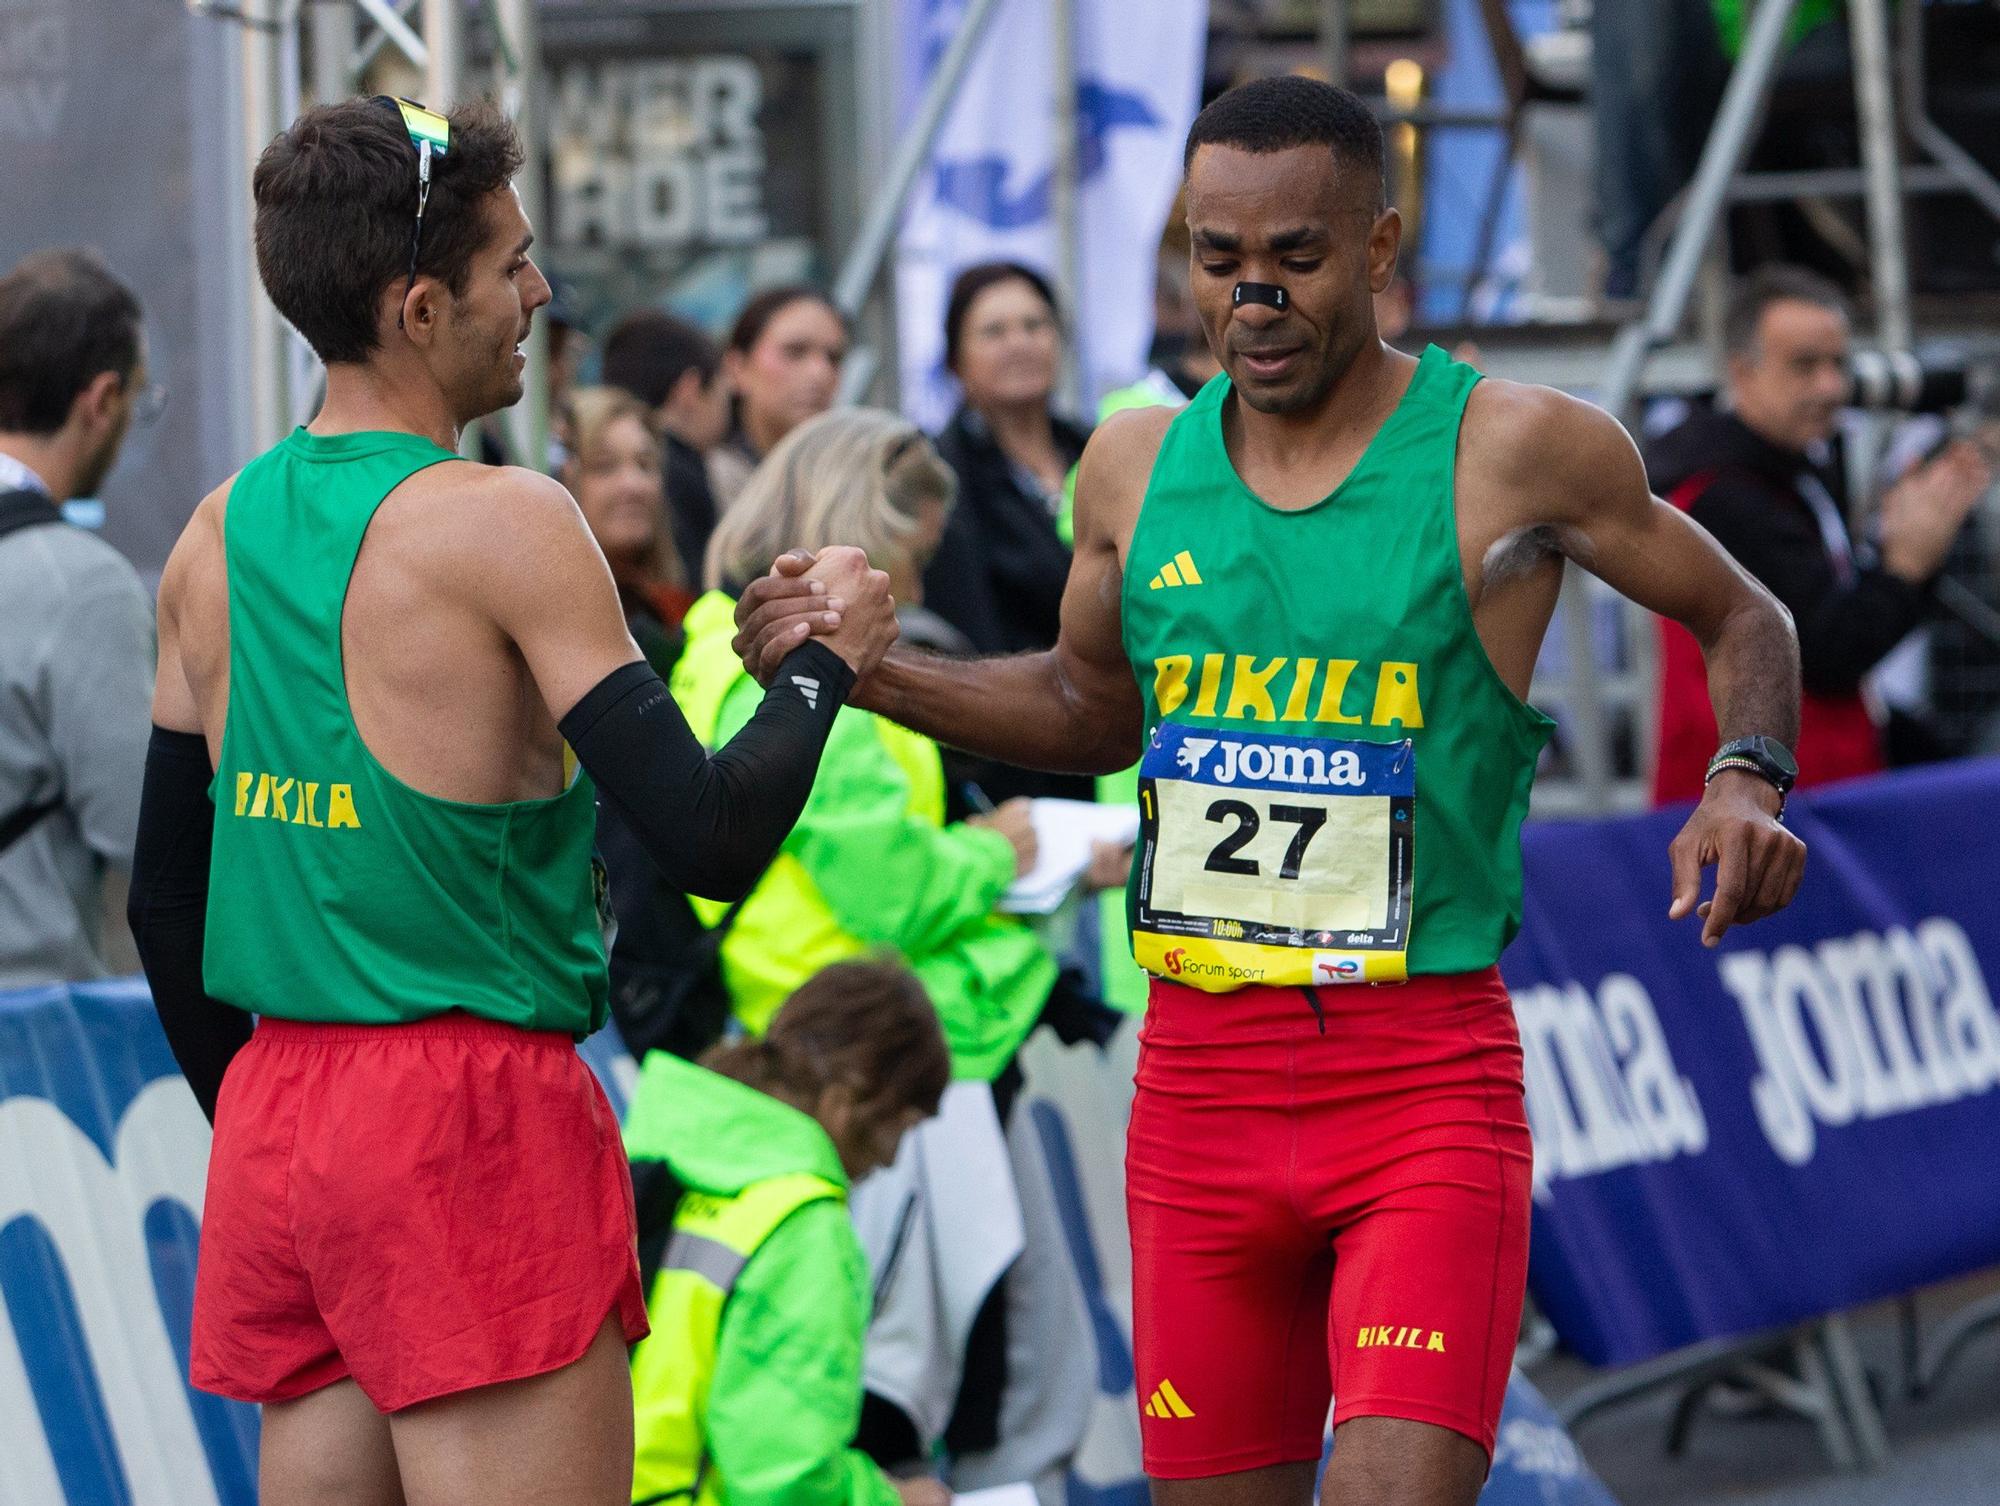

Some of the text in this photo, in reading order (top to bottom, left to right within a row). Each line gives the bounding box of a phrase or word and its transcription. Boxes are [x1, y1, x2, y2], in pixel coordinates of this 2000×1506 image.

[1154, 653, 1425, 729] BIKILA
[235, 772, 362, 828] BIKILA
[1203, 799, 1327, 880] 27
[1347, 933, 1374, 944] delta
[1228, 966, 1265, 980] sport
[1510, 972, 1708, 1195] ma
[1356, 1325, 1446, 1353] BIKILA
